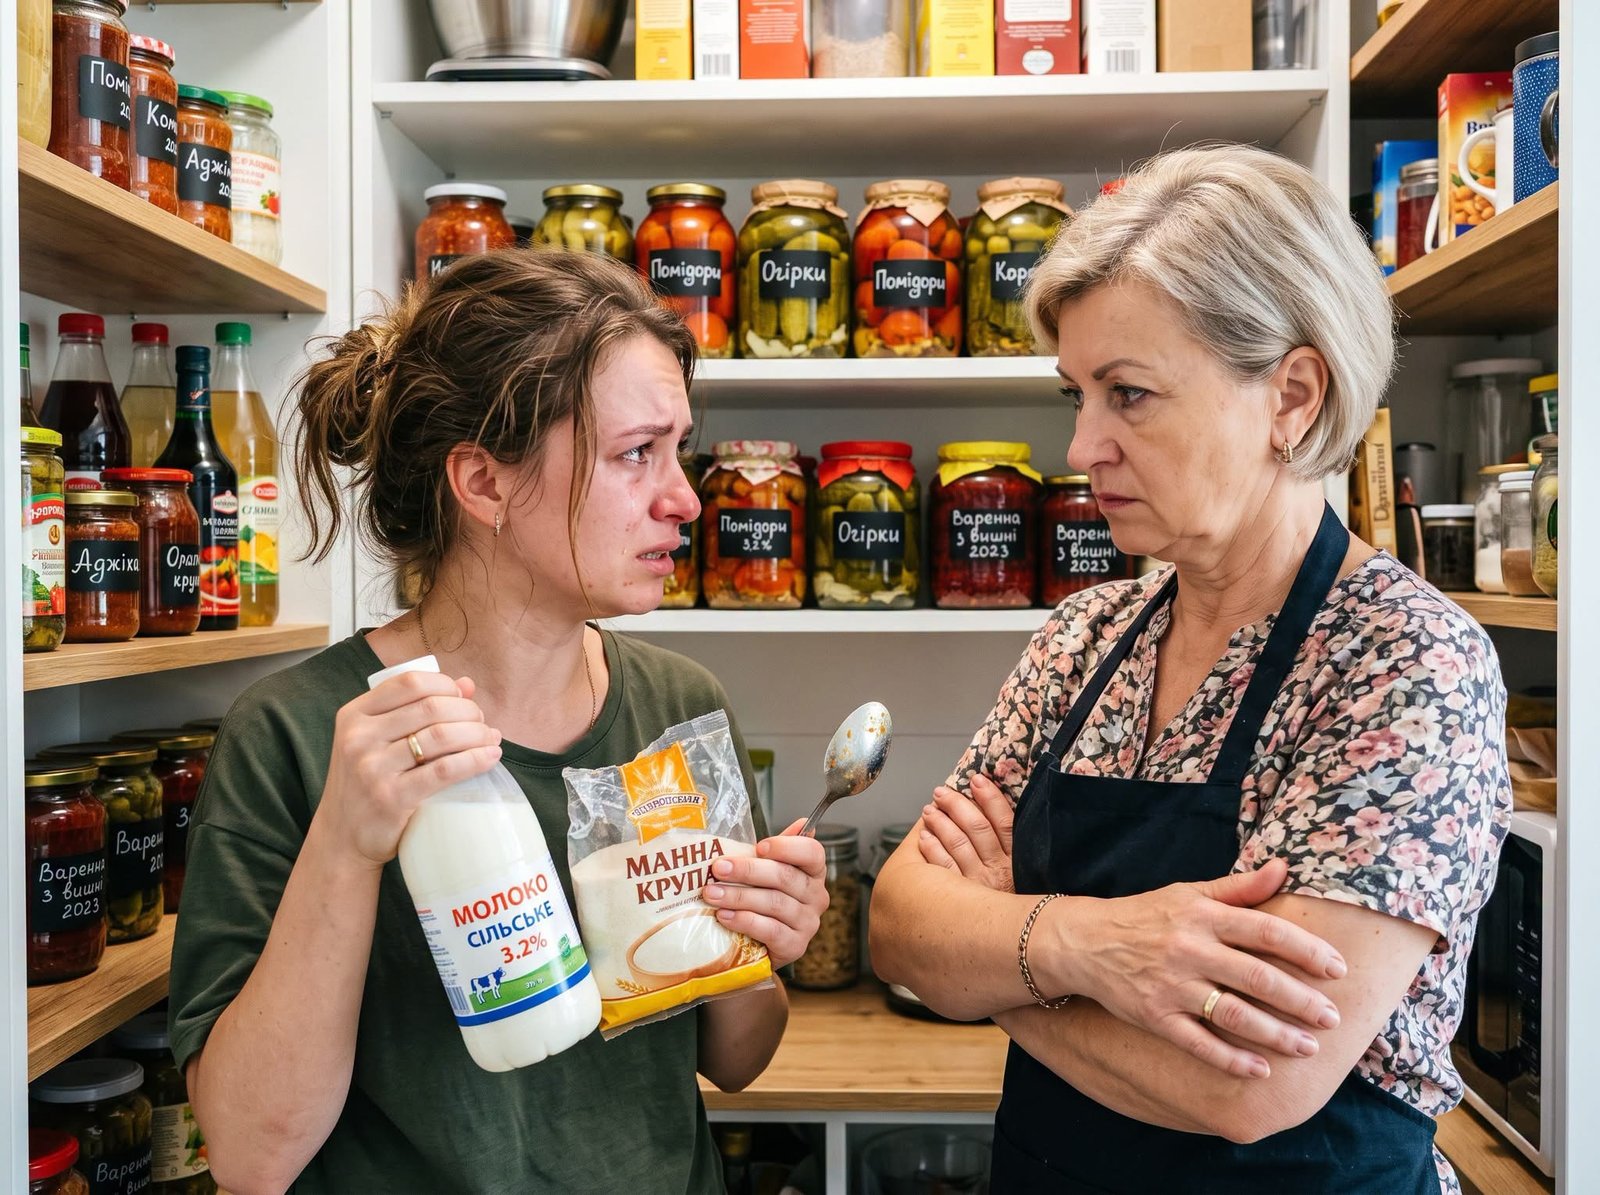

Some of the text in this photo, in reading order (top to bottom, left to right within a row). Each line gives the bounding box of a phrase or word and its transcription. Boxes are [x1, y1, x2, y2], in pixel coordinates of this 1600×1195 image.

[218, 182, 231, 198] 20
[651, 258, 721, 286] Помідори
[762, 259, 826, 288] Огірки
[876, 269, 945, 299] Помідори
[720, 515, 787, 540] Помідори
[838, 521, 900, 550] Огірки
[970, 527, 1017, 543] вишні
[969, 545, 1009, 558] 2023
[1070, 559, 1110, 573] 2023
[626, 838, 725, 880] МАННА
[62, 875, 103, 900] вишні
[451, 873, 548, 928] МОЛОКО
[62, 897, 99, 919] 2023
[467, 900, 554, 948] СІЛЬСЬКЕ
[500, 932, 548, 964] 3.2%
